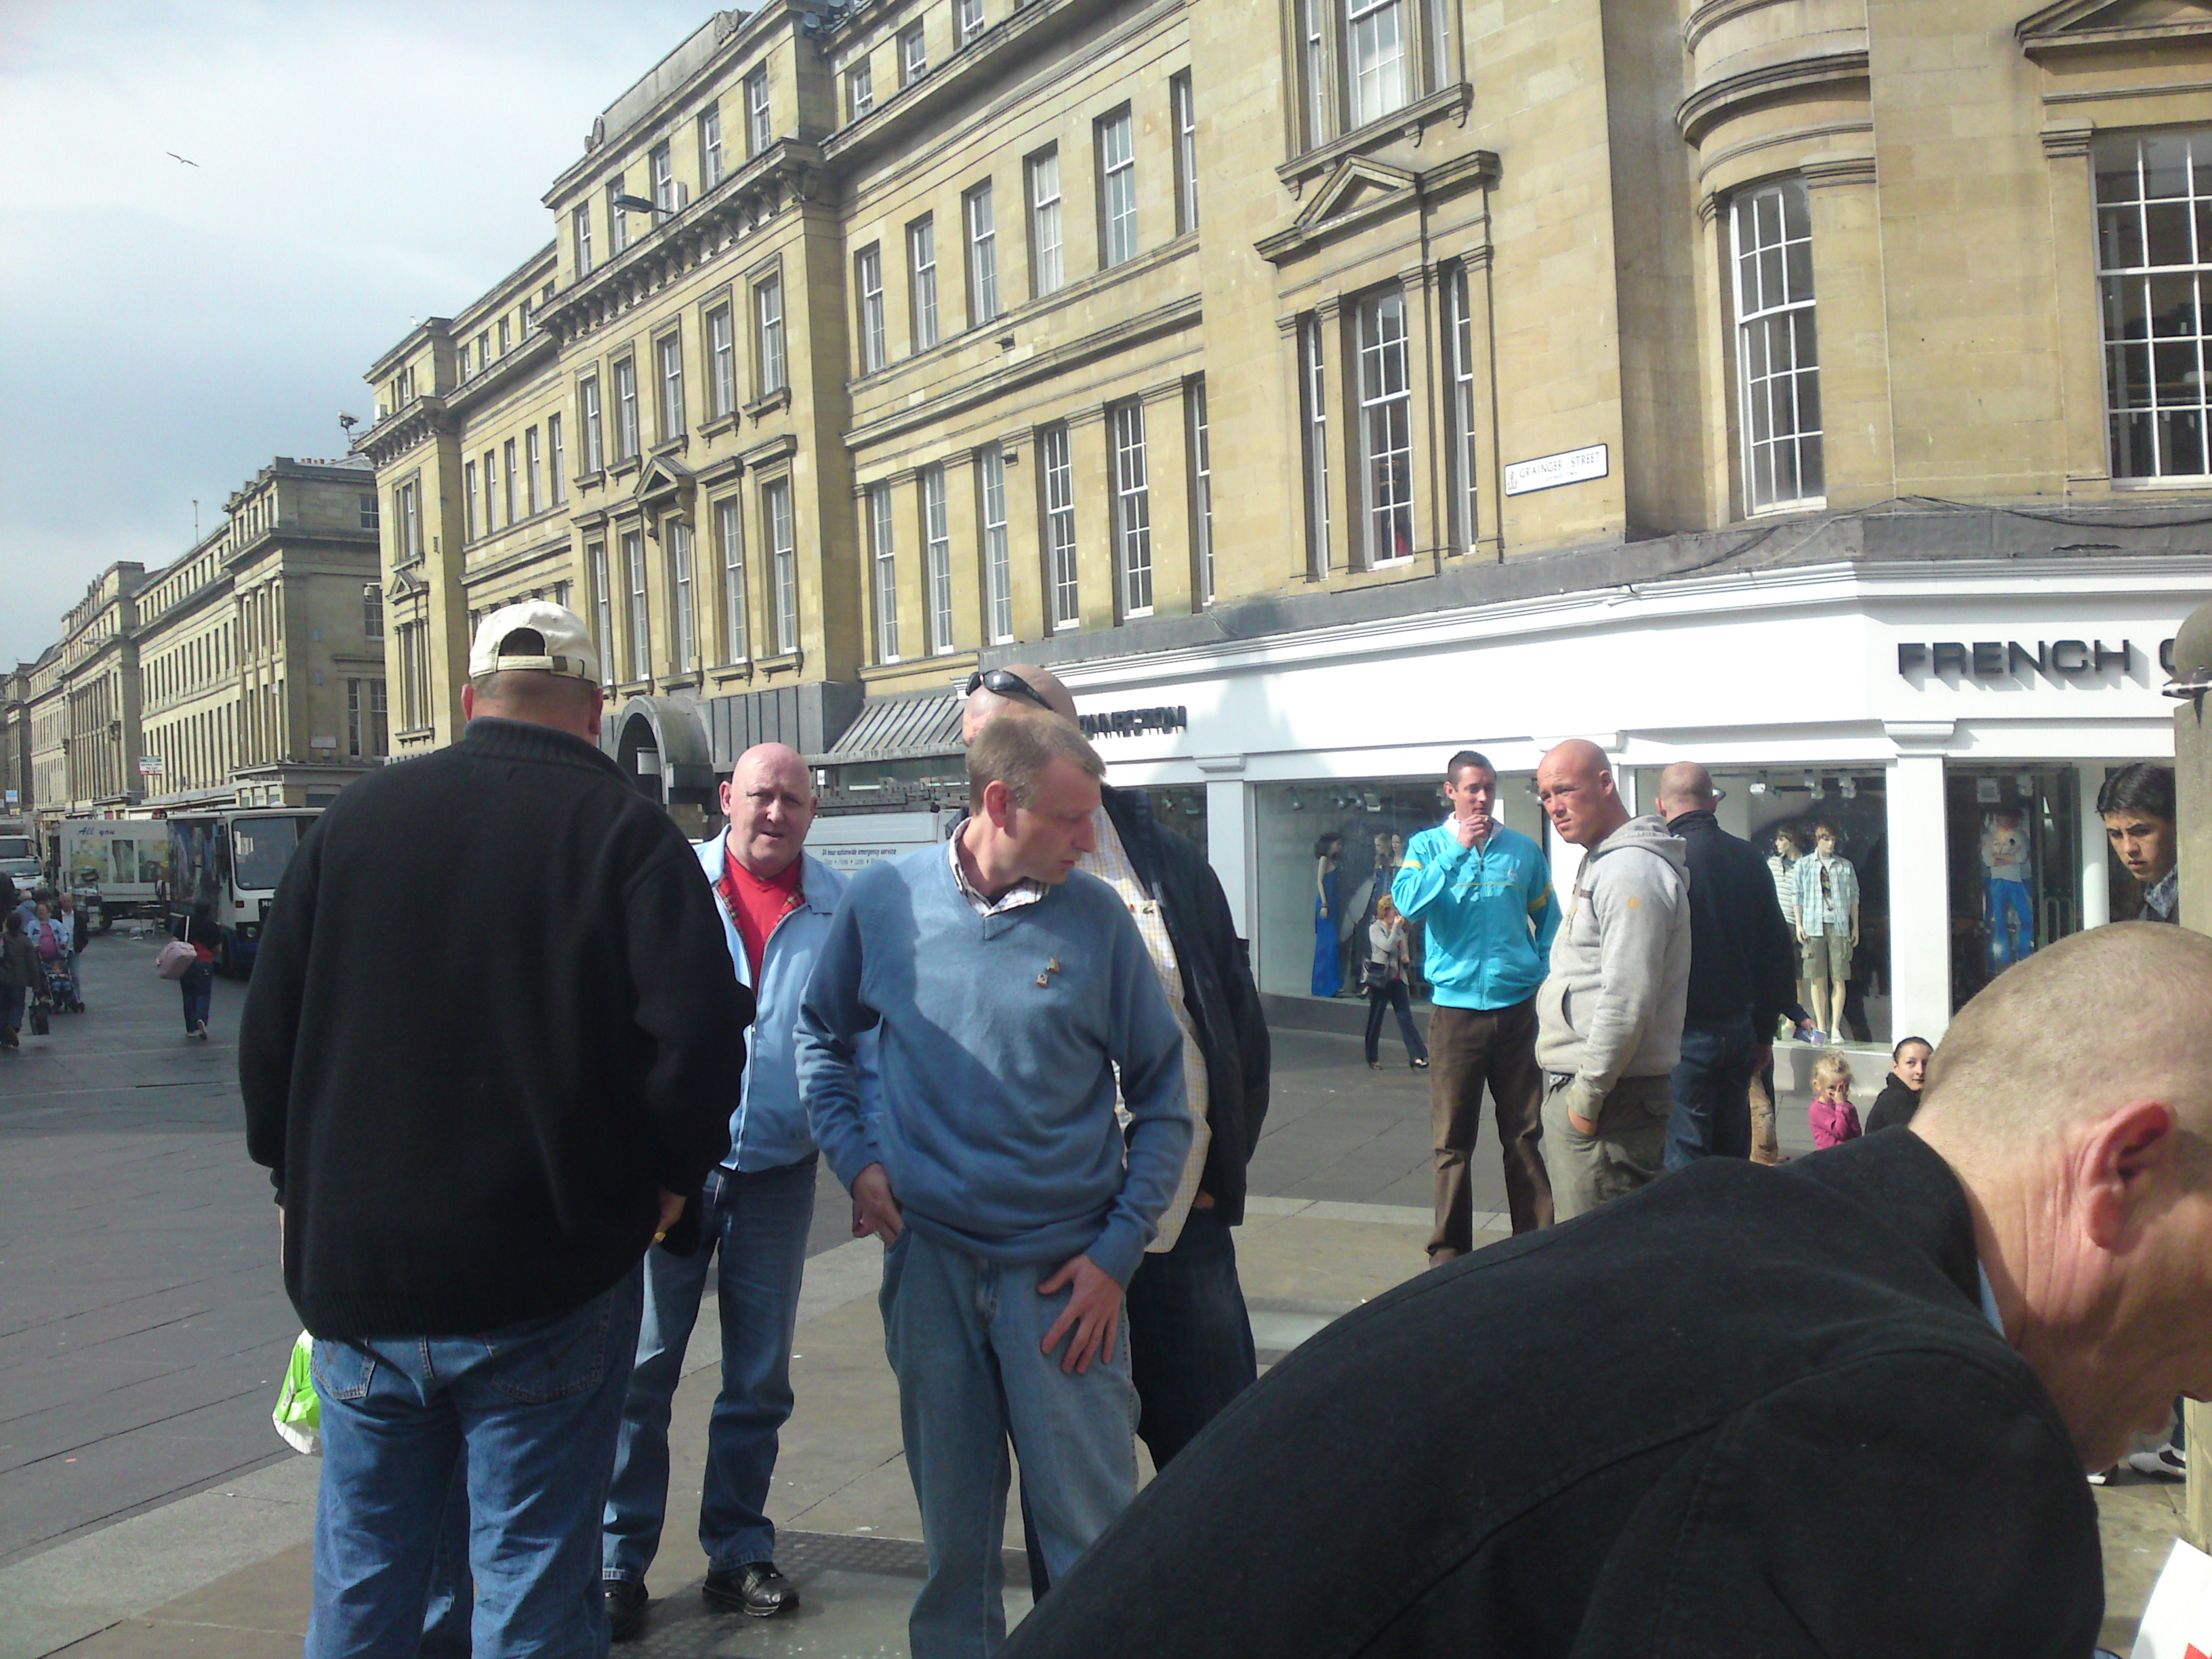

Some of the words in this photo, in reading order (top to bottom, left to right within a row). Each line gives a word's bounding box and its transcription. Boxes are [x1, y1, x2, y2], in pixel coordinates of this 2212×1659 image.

[1519, 459, 1563, 478] GRAINGER
[1571, 451, 1600, 468] STREET
[1898, 638, 2131, 676] FRENCH
[77, 827, 94, 836] All
[858, 849, 880, 857] emergency
